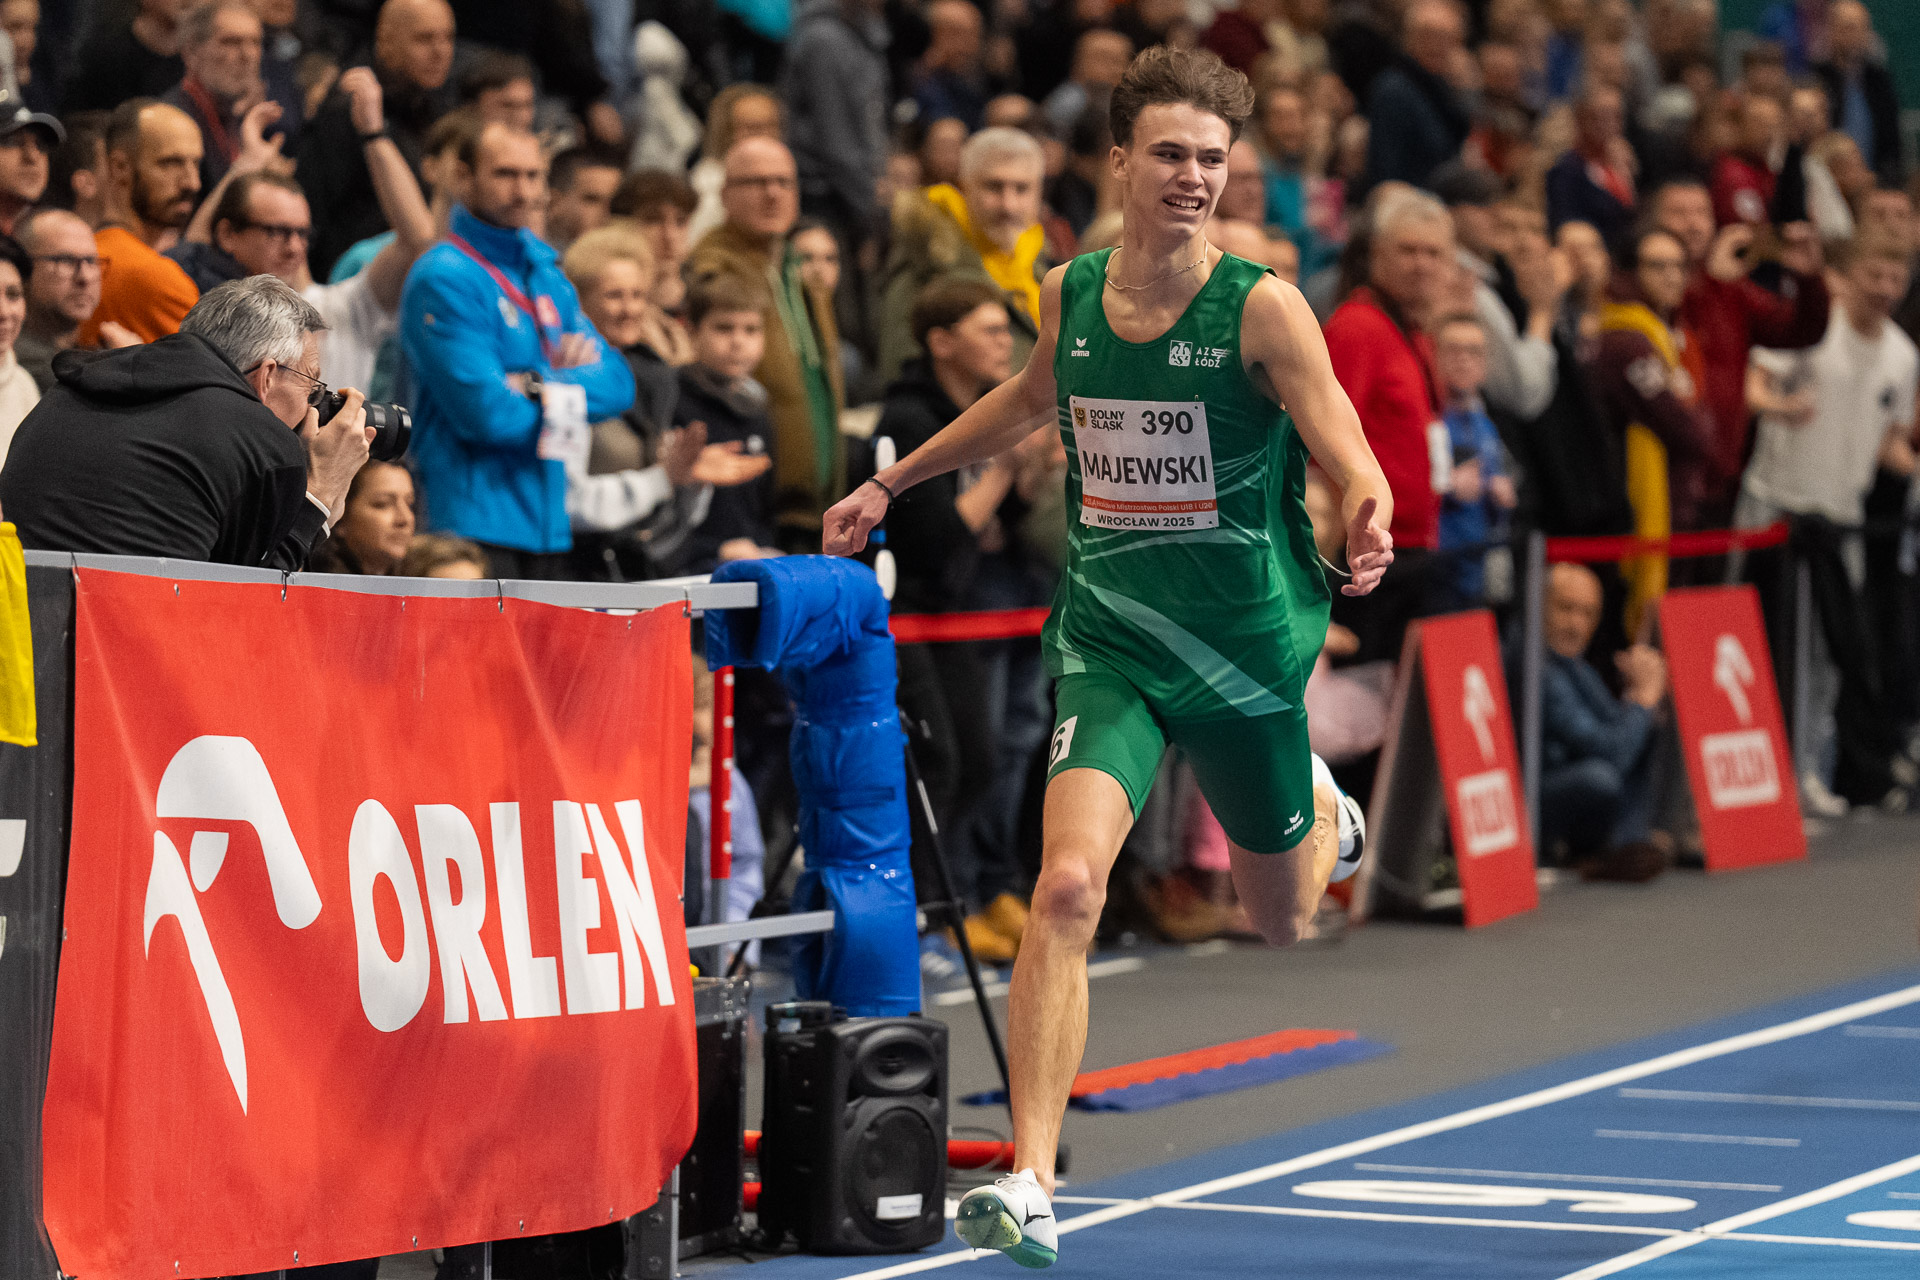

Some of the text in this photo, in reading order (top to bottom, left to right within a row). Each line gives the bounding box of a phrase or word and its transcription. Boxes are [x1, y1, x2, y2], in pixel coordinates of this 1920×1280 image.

[1071, 349, 1090, 357] erima
[1196, 346, 1228, 358] AZS
[1090, 409, 1125, 420] DOLNY
[1091, 418, 1124, 431] ŚLĄSK
[1141, 410, 1193, 435] 390
[1083, 450, 1207, 484] MAJEWSKI
[1117, 503, 1157, 511] Mistrzostwa
[1159, 503, 1179, 511] Polski
[1198, 502, 1213, 510] U20
[1097, 513, 1195, 527] WROCŁAW 2025
[1050, 725, 1066, 767] 6
[348, 798, 676, 1033] ORLEN
